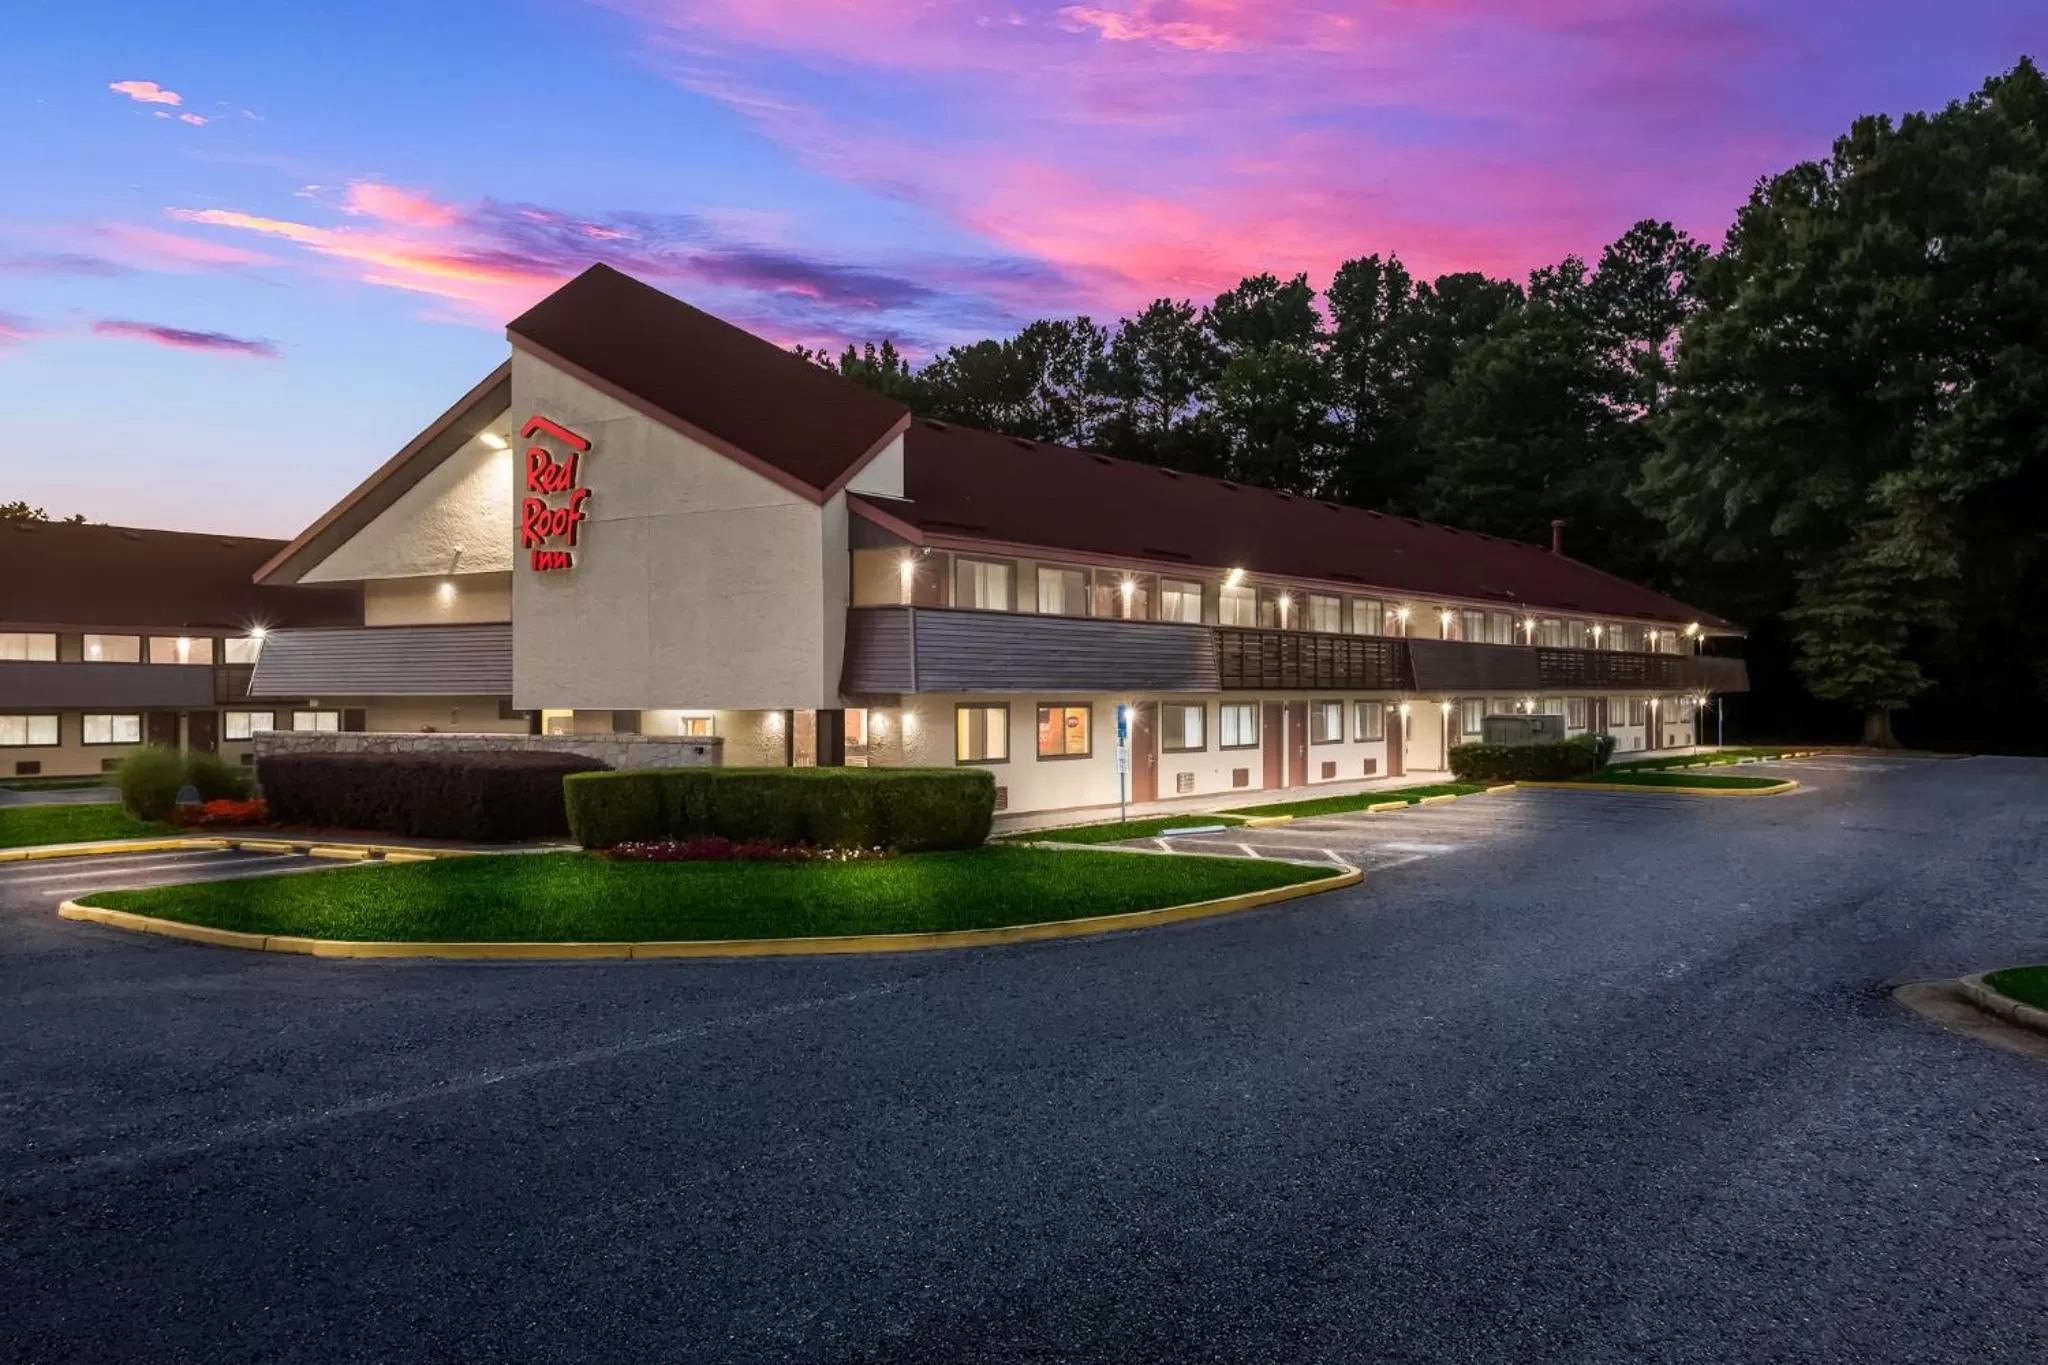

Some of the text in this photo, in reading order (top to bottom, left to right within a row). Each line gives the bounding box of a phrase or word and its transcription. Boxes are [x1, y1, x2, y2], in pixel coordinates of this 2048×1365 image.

[527, 448, 579, 494] Red
[521, 488, 591, 548] Roof
[531, 550, 573, 571] Inn
